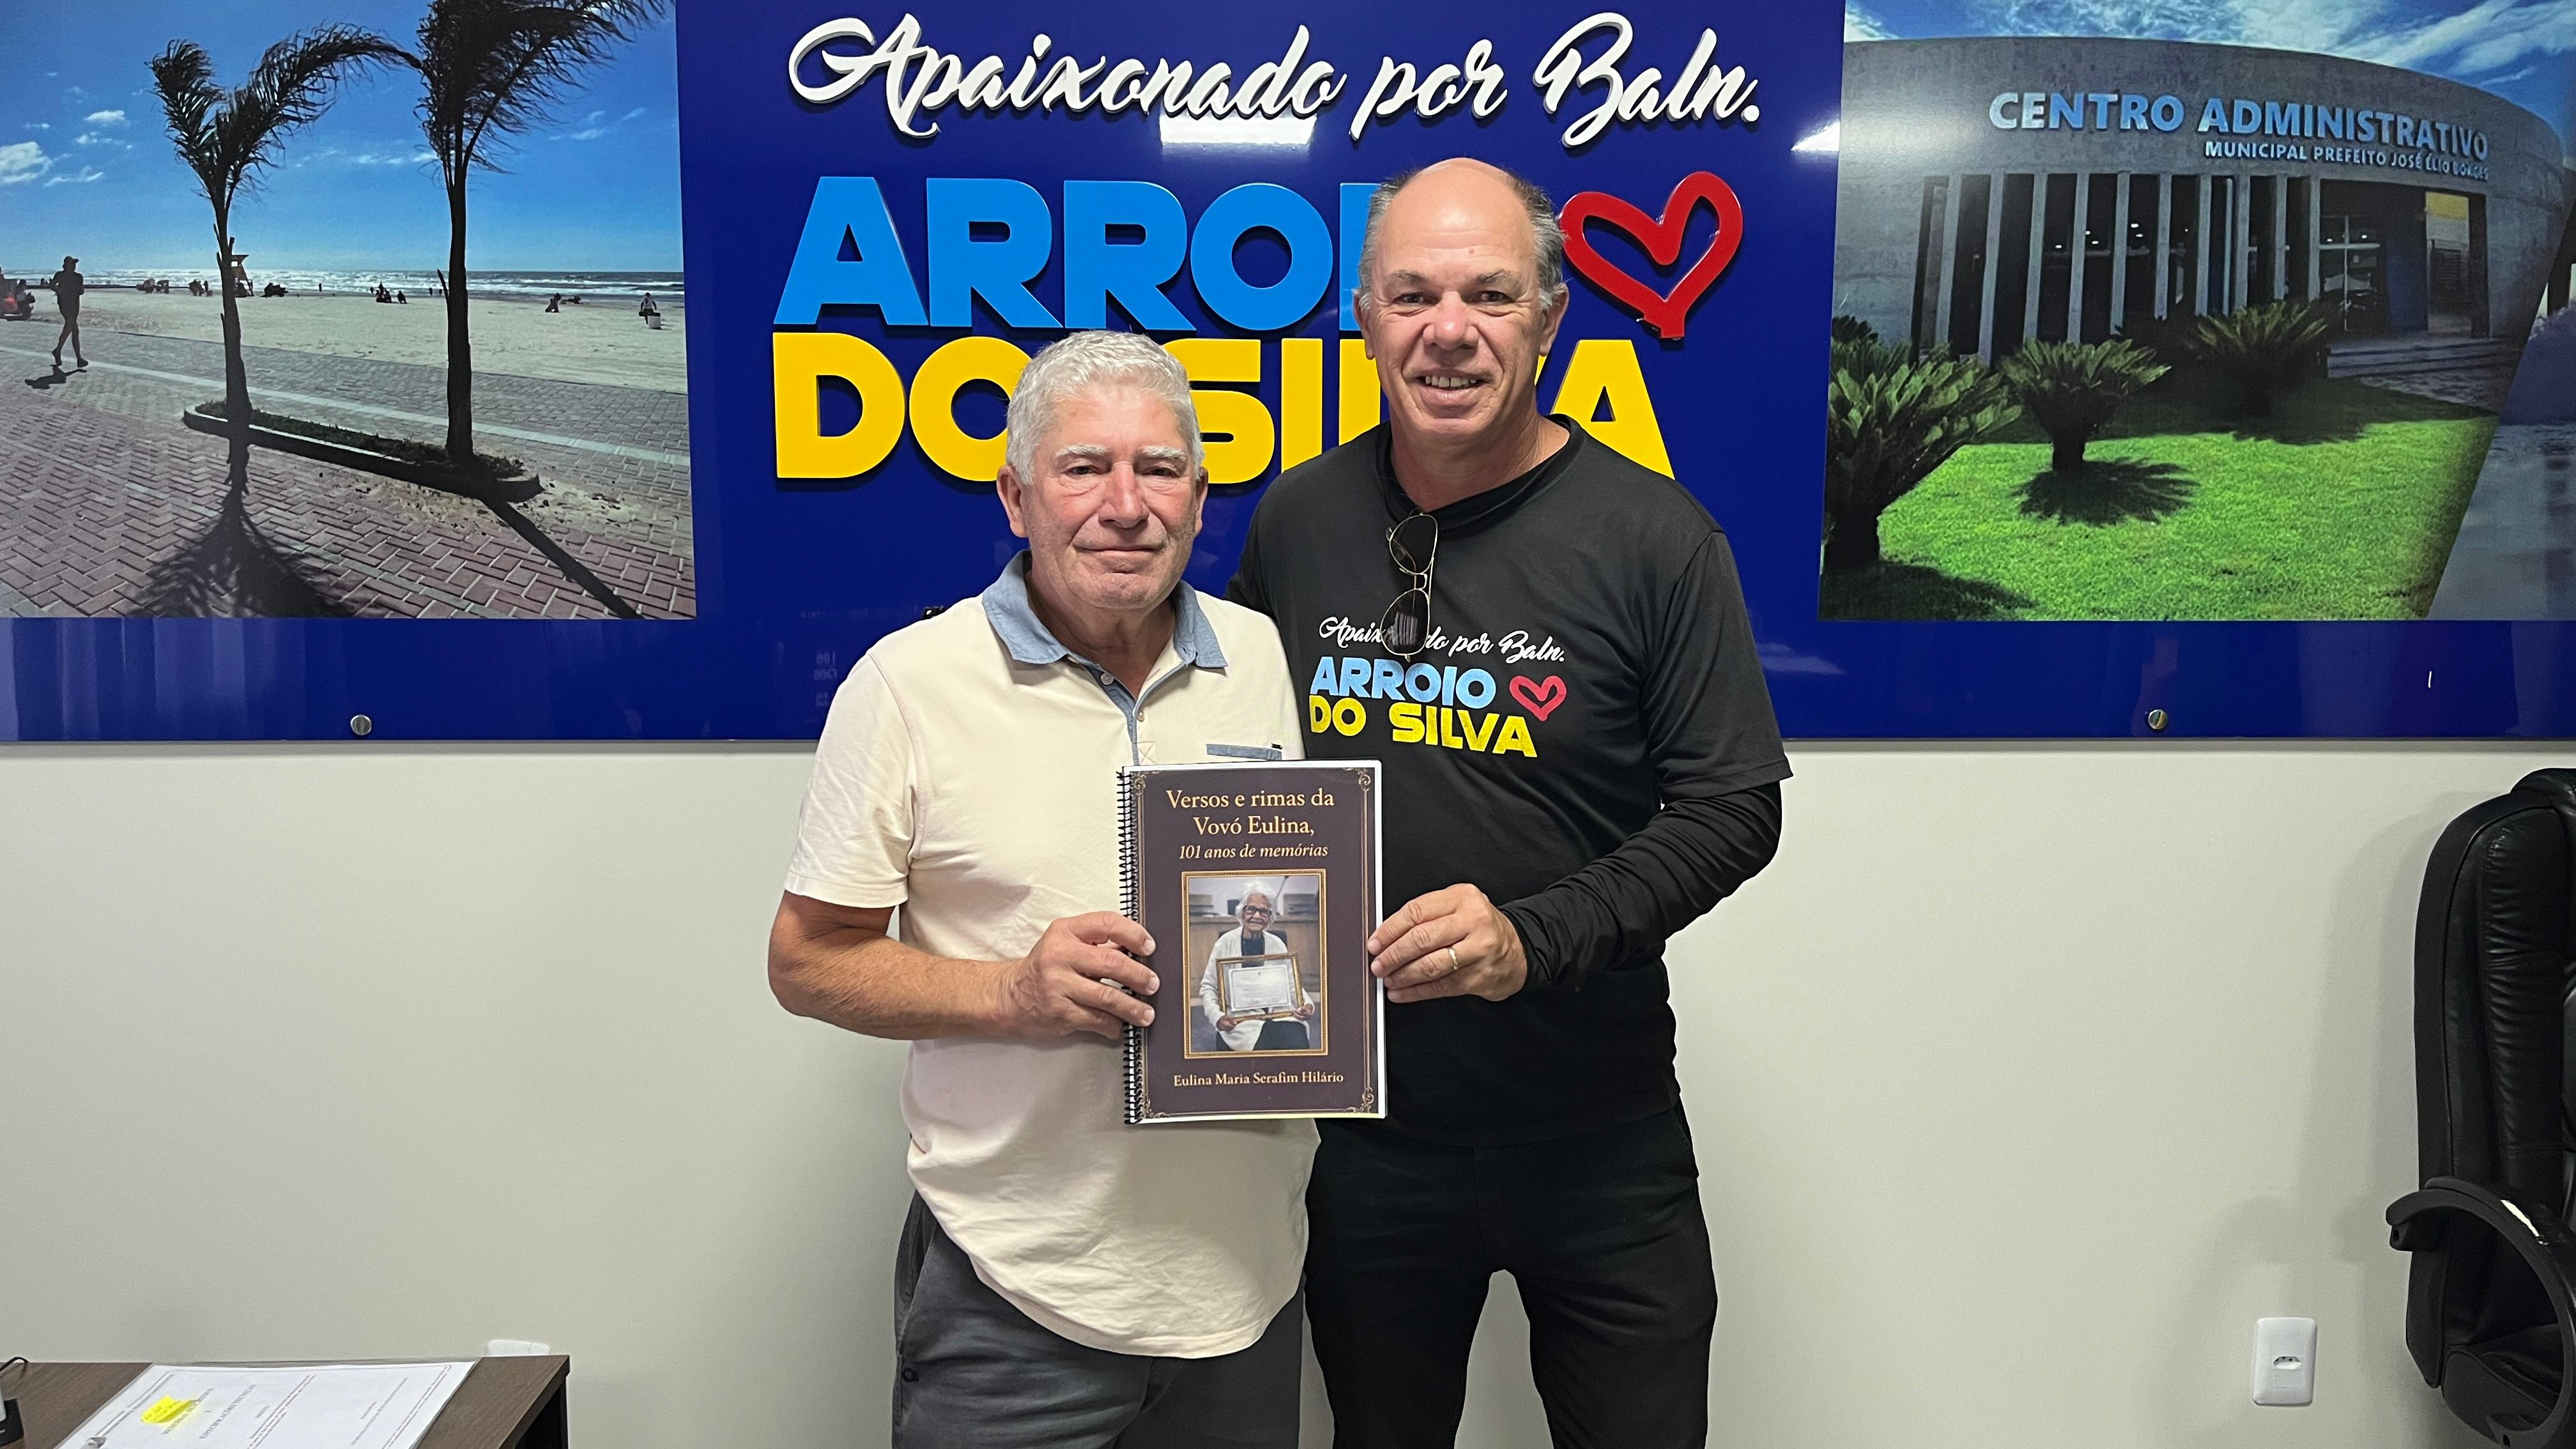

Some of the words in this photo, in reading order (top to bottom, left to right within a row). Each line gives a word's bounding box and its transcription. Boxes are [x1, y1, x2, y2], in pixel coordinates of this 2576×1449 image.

[789, 13, 1347, 136] Apaixonado
[1350, 39, 1508, 139] por
[1535, 12, 1759, 146] Baln.
[1988, 91, 2184, 131] CENTRO
[2197, 98, 2488, 160] ADMINISTRATIVO
[2205, 141, 2308, 160] MUNICIPAL
[2313, 146, 2386, 165] PREFEITO
[2391, 152, 2422, 170] JOSÉ
[772, 176, 1382, 331] ARROI
[1319, 617, 1450, 650] Apaixdo
[1448, 632, 1494, 657] por
[1498, 630, 1565, 664] Baln.
[1310, 656, 1496, 709] ARROIO
[1309, 694, 1367, 737] DO
[1389, 702, 1538, 758] SILVA
[1166, 790, 1229, 809] Versos
[1234, 795, 1245, 808] e
[1250, 790, 1305, 807] rimas
[1310, 788, 1335, 806] da
[1193, 816, 1242, 836] Vovó
[1248, 815, 1314, 836] Eulina,
[1179, 845, 1201, 859] 101
[1204, 848, 1236, 859] anos
[1239, 843, 1256, 858] de
[1260, 843, 1328, 857] memórias
[1174, 1075, 1212, 1087] Eulina
[1215, 1073, 1250, 1085] Maria
[1253, 1071, 1298, 1084] Serafim
[1301, 1071, 1344, 1083] Hilário
